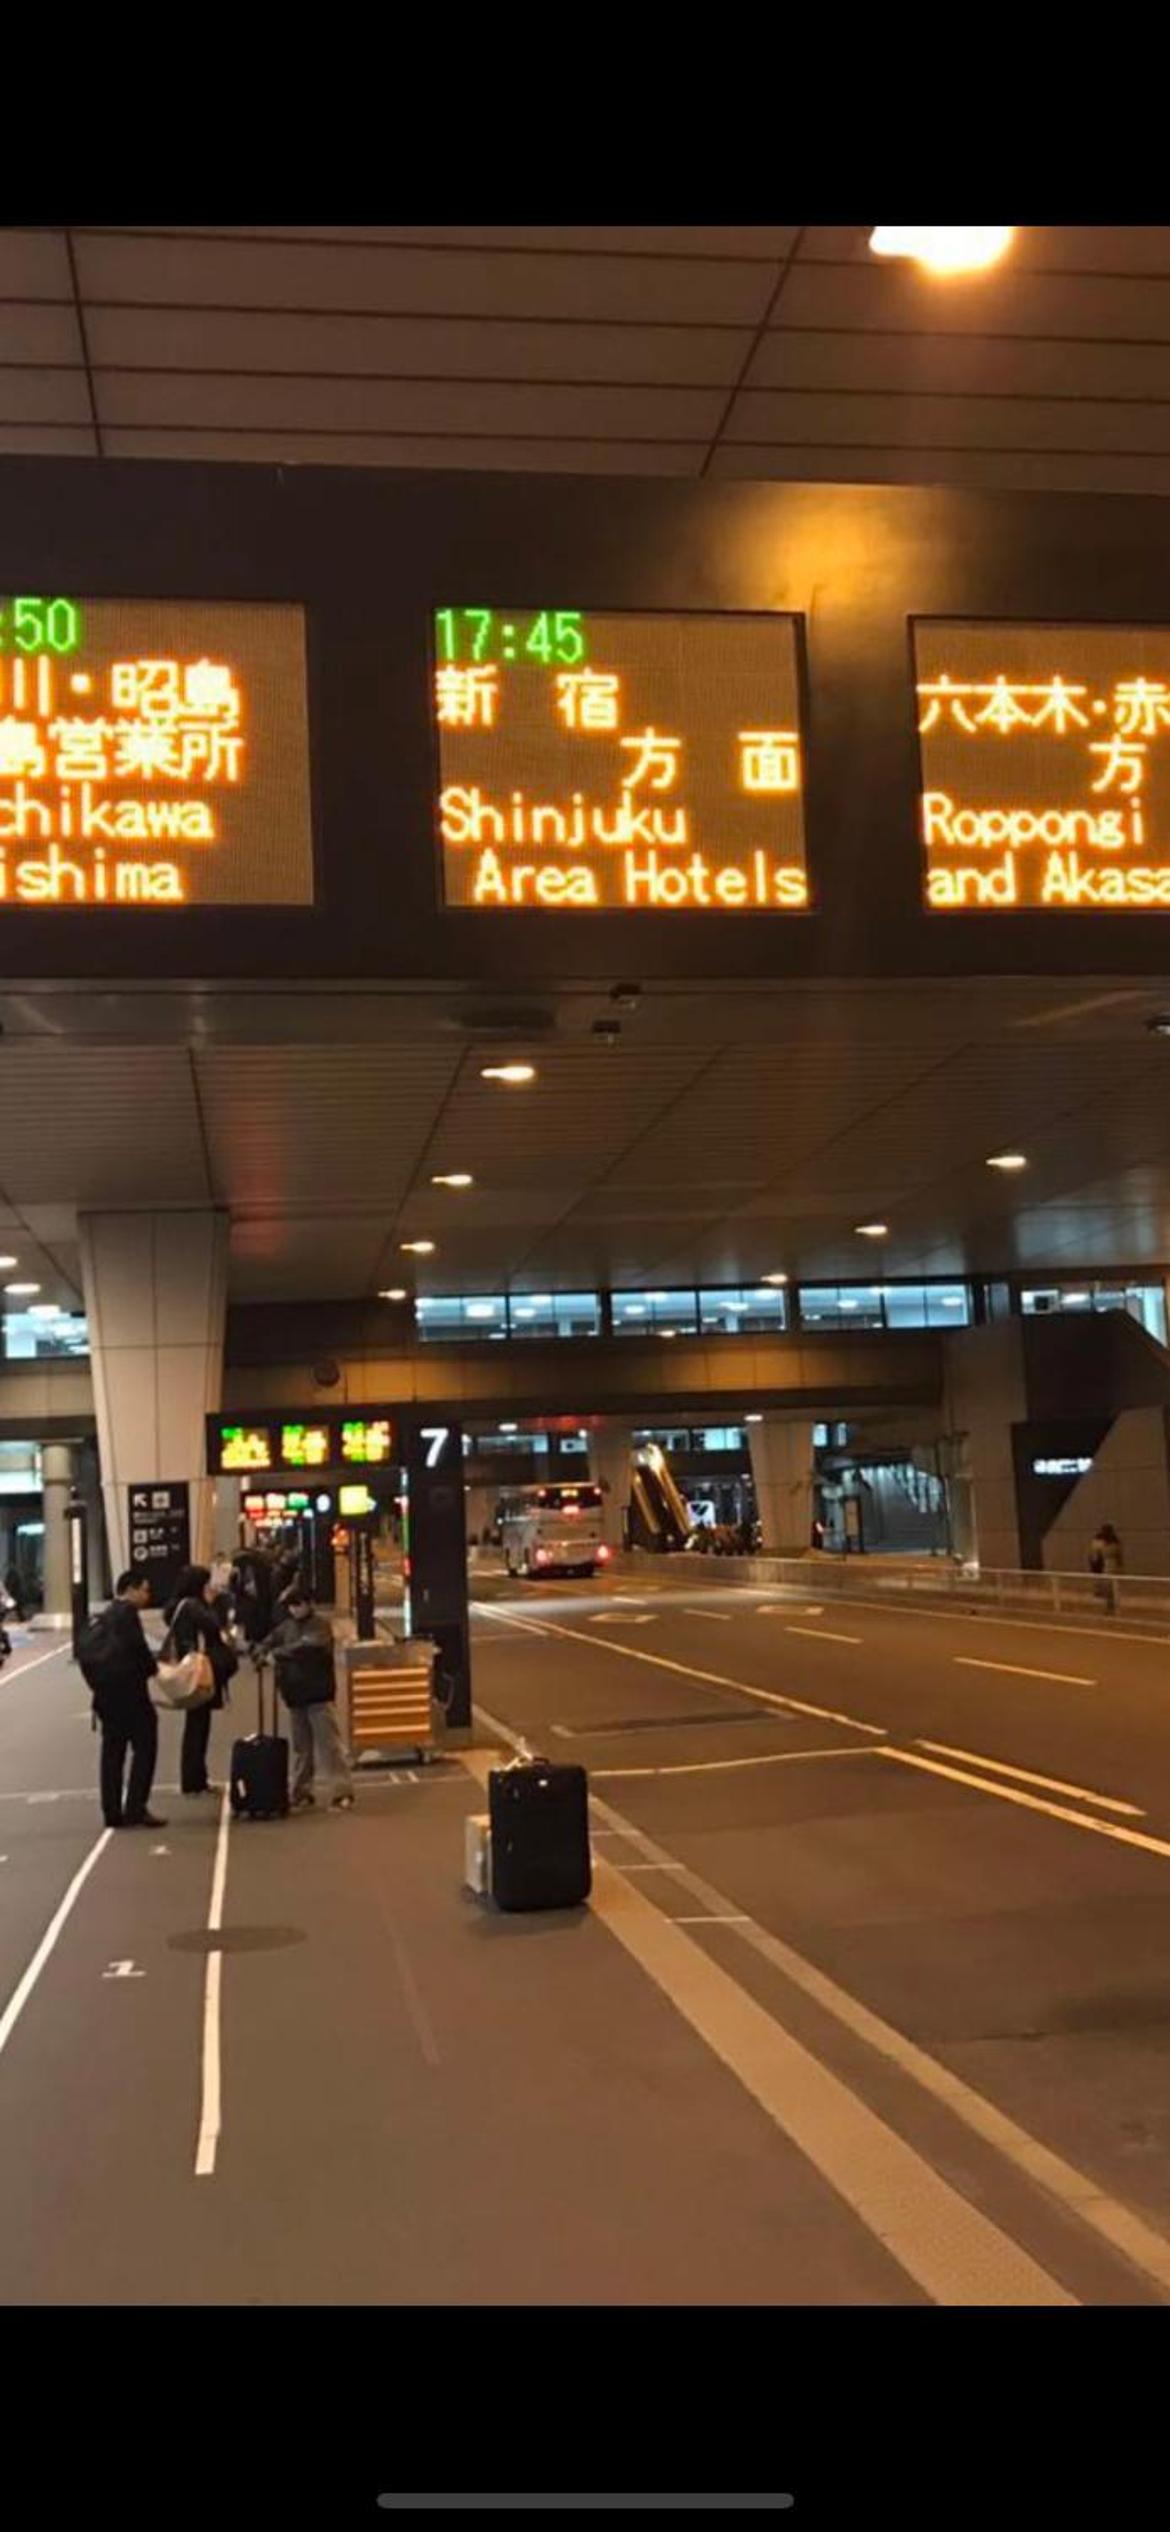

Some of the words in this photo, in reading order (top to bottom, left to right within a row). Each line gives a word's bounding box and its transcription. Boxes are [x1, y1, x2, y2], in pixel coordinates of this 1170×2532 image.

[436, 609, 584, 664] 17:45
[1088, 733, 1147, 793] 方
[439, 785, 688, 847] Shinjuku
[922, 792, 1144, 849] Roppongi
[473, 847, 598, 902] Area
[624, 849, 808, 903] Hotels
[927, 850, 1017, 905] and
[420, 1427, 449, 1468] 7
